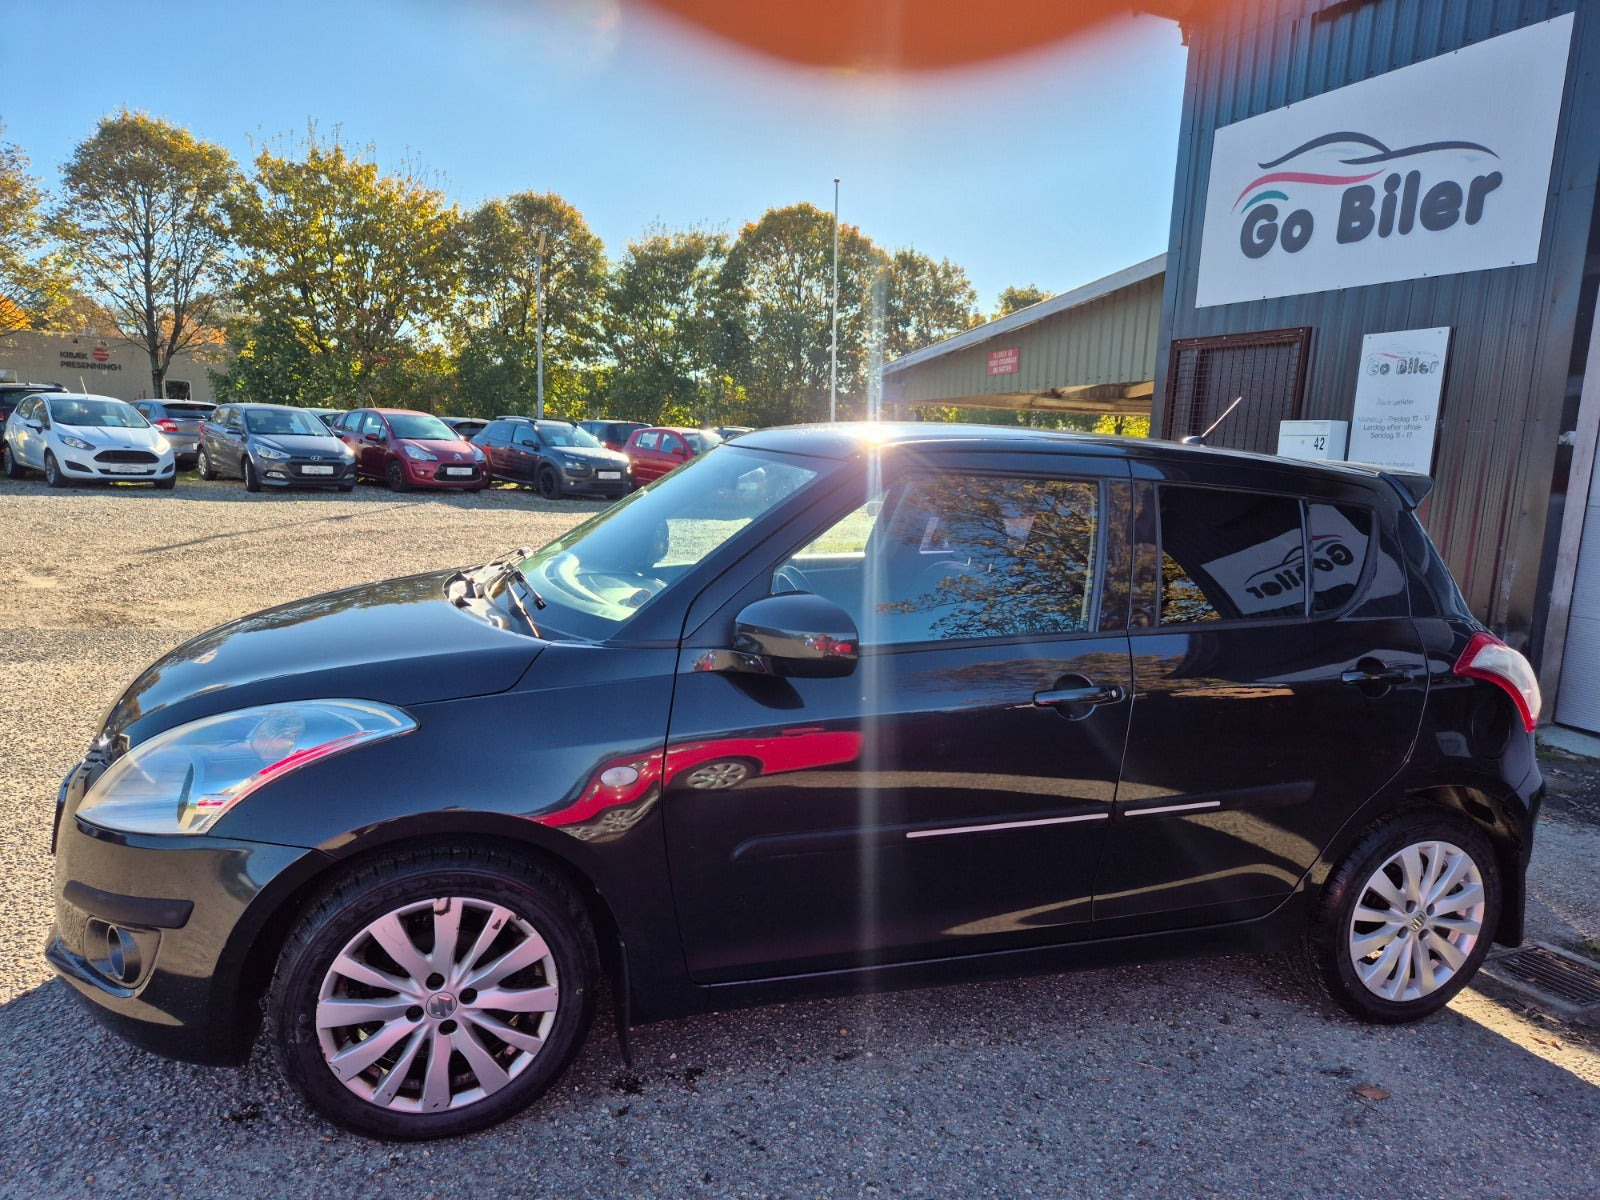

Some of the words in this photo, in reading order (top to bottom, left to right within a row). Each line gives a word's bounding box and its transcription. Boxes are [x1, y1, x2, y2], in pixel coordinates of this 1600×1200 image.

[1240, 203, 1314, 259] Go
[1336, 169, 1503, 245] Biler
[59, 351, 88, 360] KIBÆK
[1367, 361, 1390, 376] Go
[1396, 357, 1439, 375] Biler
[1313, 436, 1325, 450] 42
